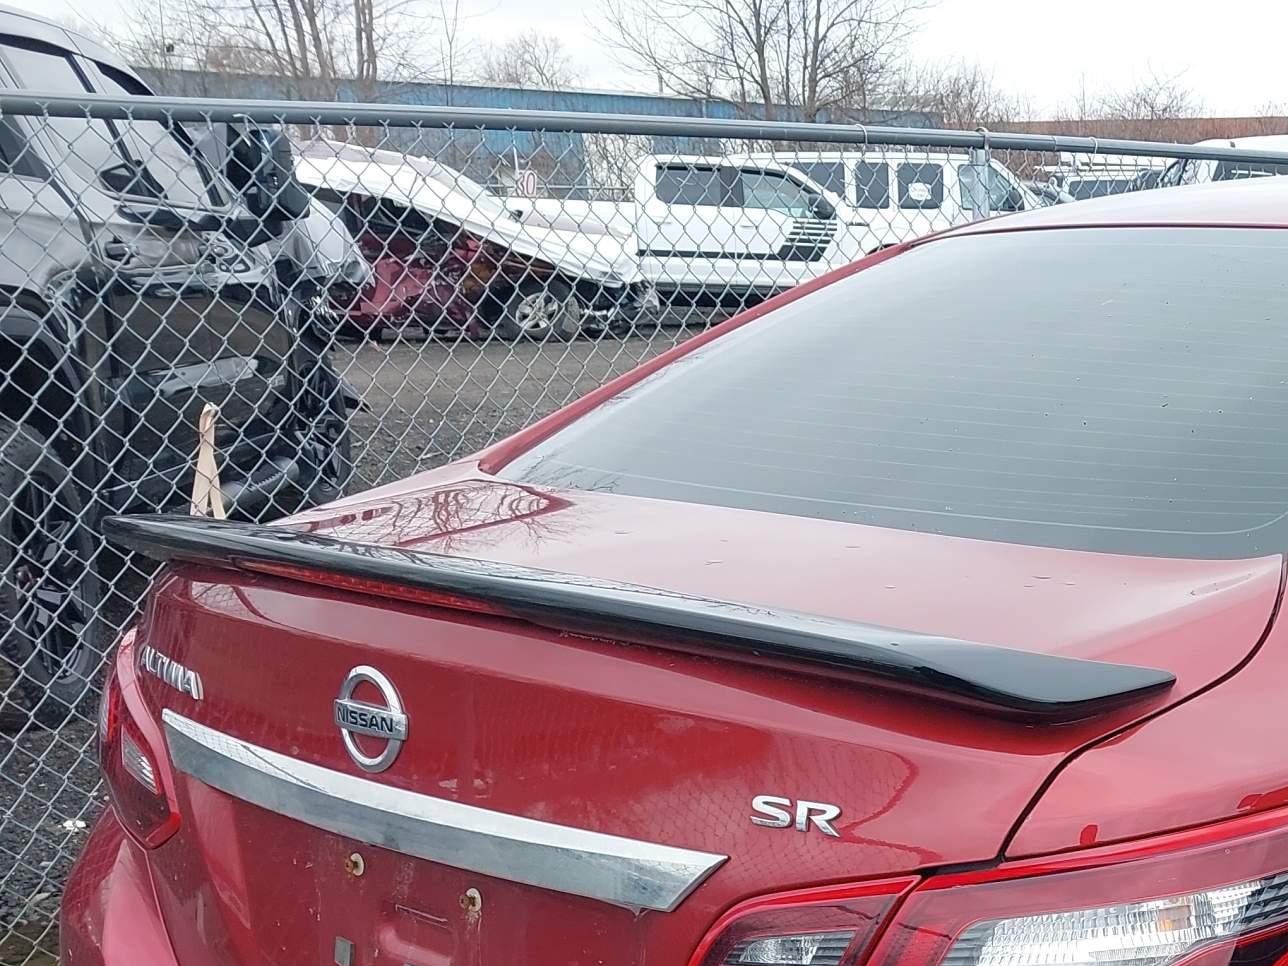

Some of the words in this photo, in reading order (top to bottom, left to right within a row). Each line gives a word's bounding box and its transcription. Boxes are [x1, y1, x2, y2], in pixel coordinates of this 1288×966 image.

[141, 645, 204, 700] ALTIMA
[337, 703, 393, 732] NISSAN
[750, 795, 841, 837] SR
